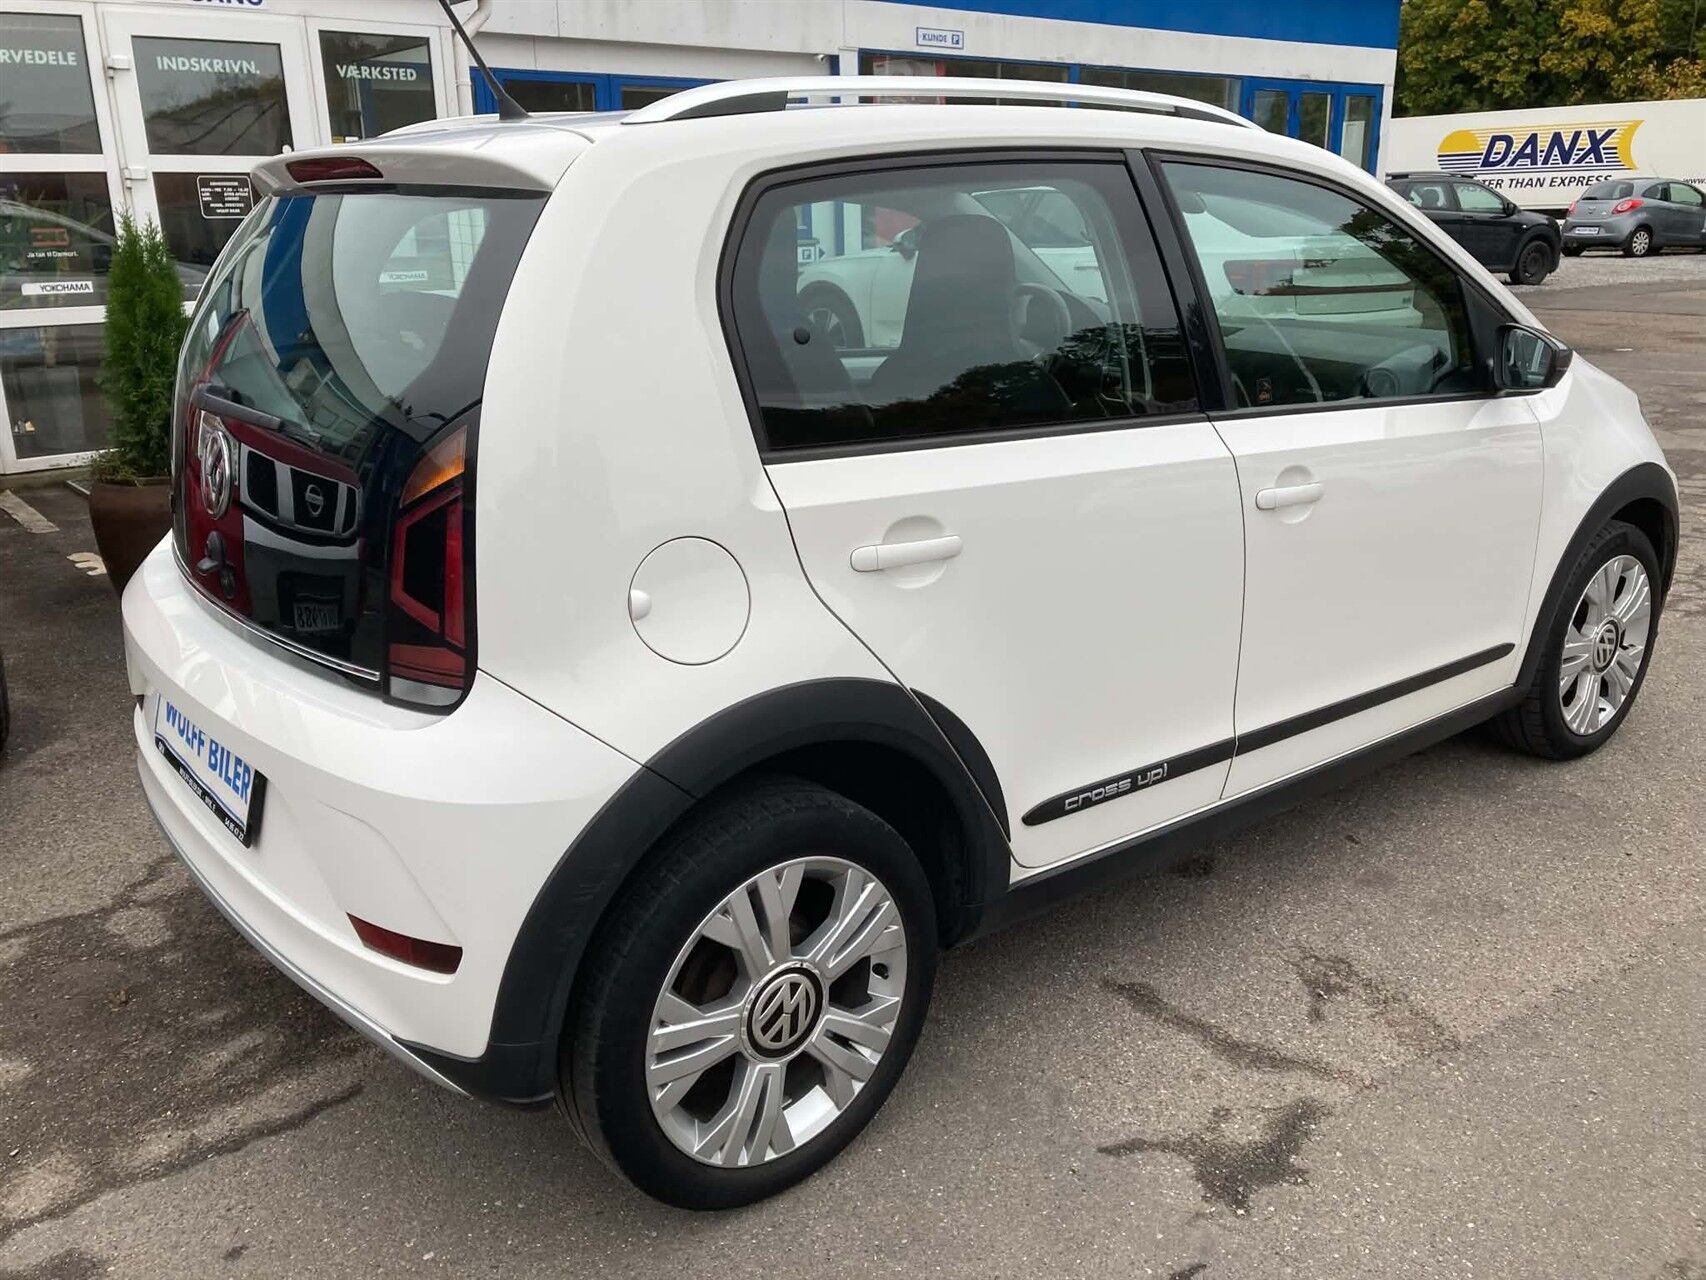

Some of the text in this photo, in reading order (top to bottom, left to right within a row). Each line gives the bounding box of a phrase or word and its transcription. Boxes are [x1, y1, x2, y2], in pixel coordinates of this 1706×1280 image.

[922, 33, 947, 43] KUNDE
[0, 48, 77, 66] RVEDELE
[156, 56, 260, 74] INDSKRIVN.
[336, 63, 417, 81] VÆRKSTED
[1480, 128, 1617, 168] DANX
[1508, 177, 1546, 189] THAN
[40, 283, 91, 293] YOKOHAMA
[166, 701, 206, 758] WULFF
[207, 738, 251, 806] BILER
[1064, 778, 1131, 810] cross
